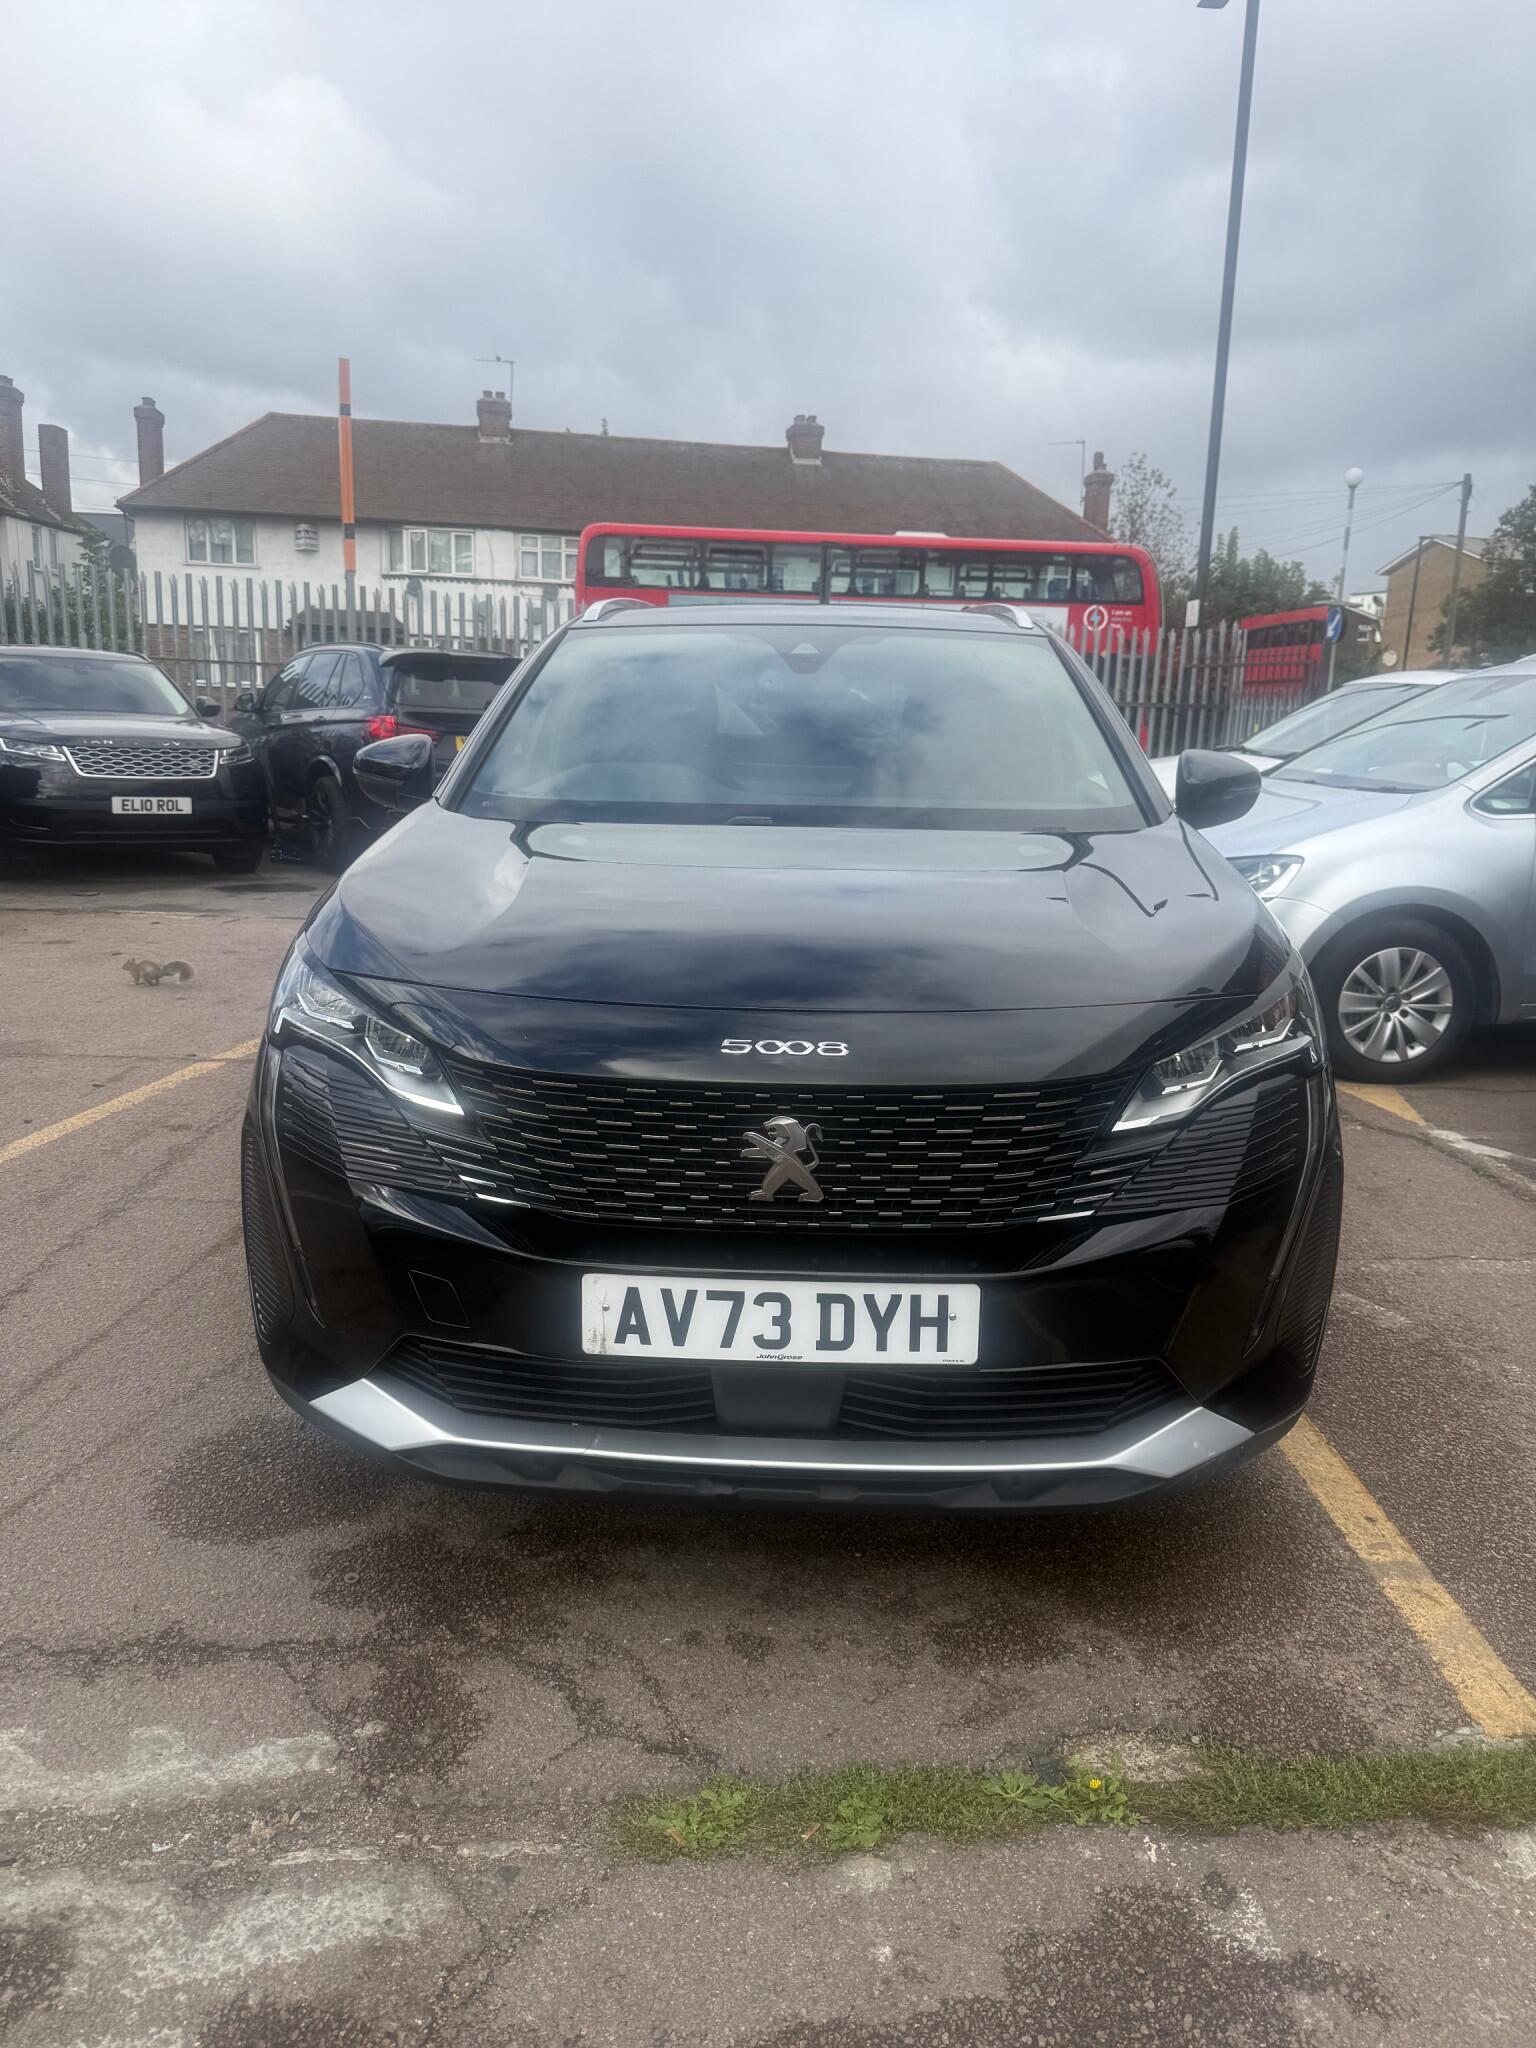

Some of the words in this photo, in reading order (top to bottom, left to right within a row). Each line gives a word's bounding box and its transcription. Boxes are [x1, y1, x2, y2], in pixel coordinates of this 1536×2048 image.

[121, 799, 153, 812] EL10
[157, 799, 184, 812] ROL
[721, 1039, 850, 1056] 5008
[614, 1286, 792, 1350] AV73
[816, 1293, 949, 1352] DYH
